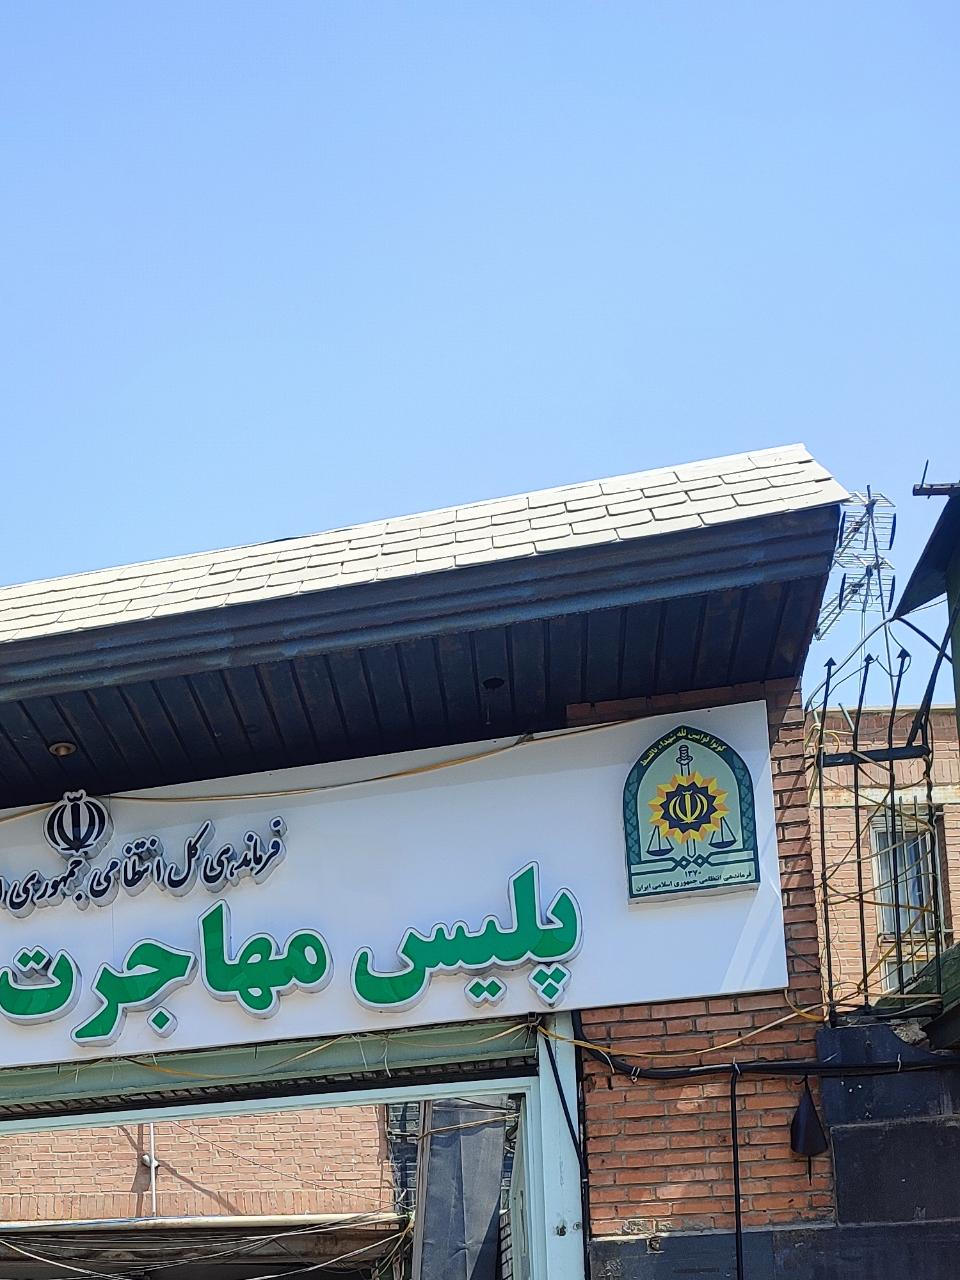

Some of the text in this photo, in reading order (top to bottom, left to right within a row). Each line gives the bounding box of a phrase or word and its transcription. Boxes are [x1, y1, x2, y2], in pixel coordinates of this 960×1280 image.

[90, 837, 162, 900] انتظامی
[167, 821, 211, 888] کل
[203, 818, 283, 884] فرماندهی
[635, 869, 752, 892] فرماندهی انتظامی جمهوری اسلامی ایران
[8, 857, 83, 910] جمهوری
[355, 866, 578, 1004] پلیس
